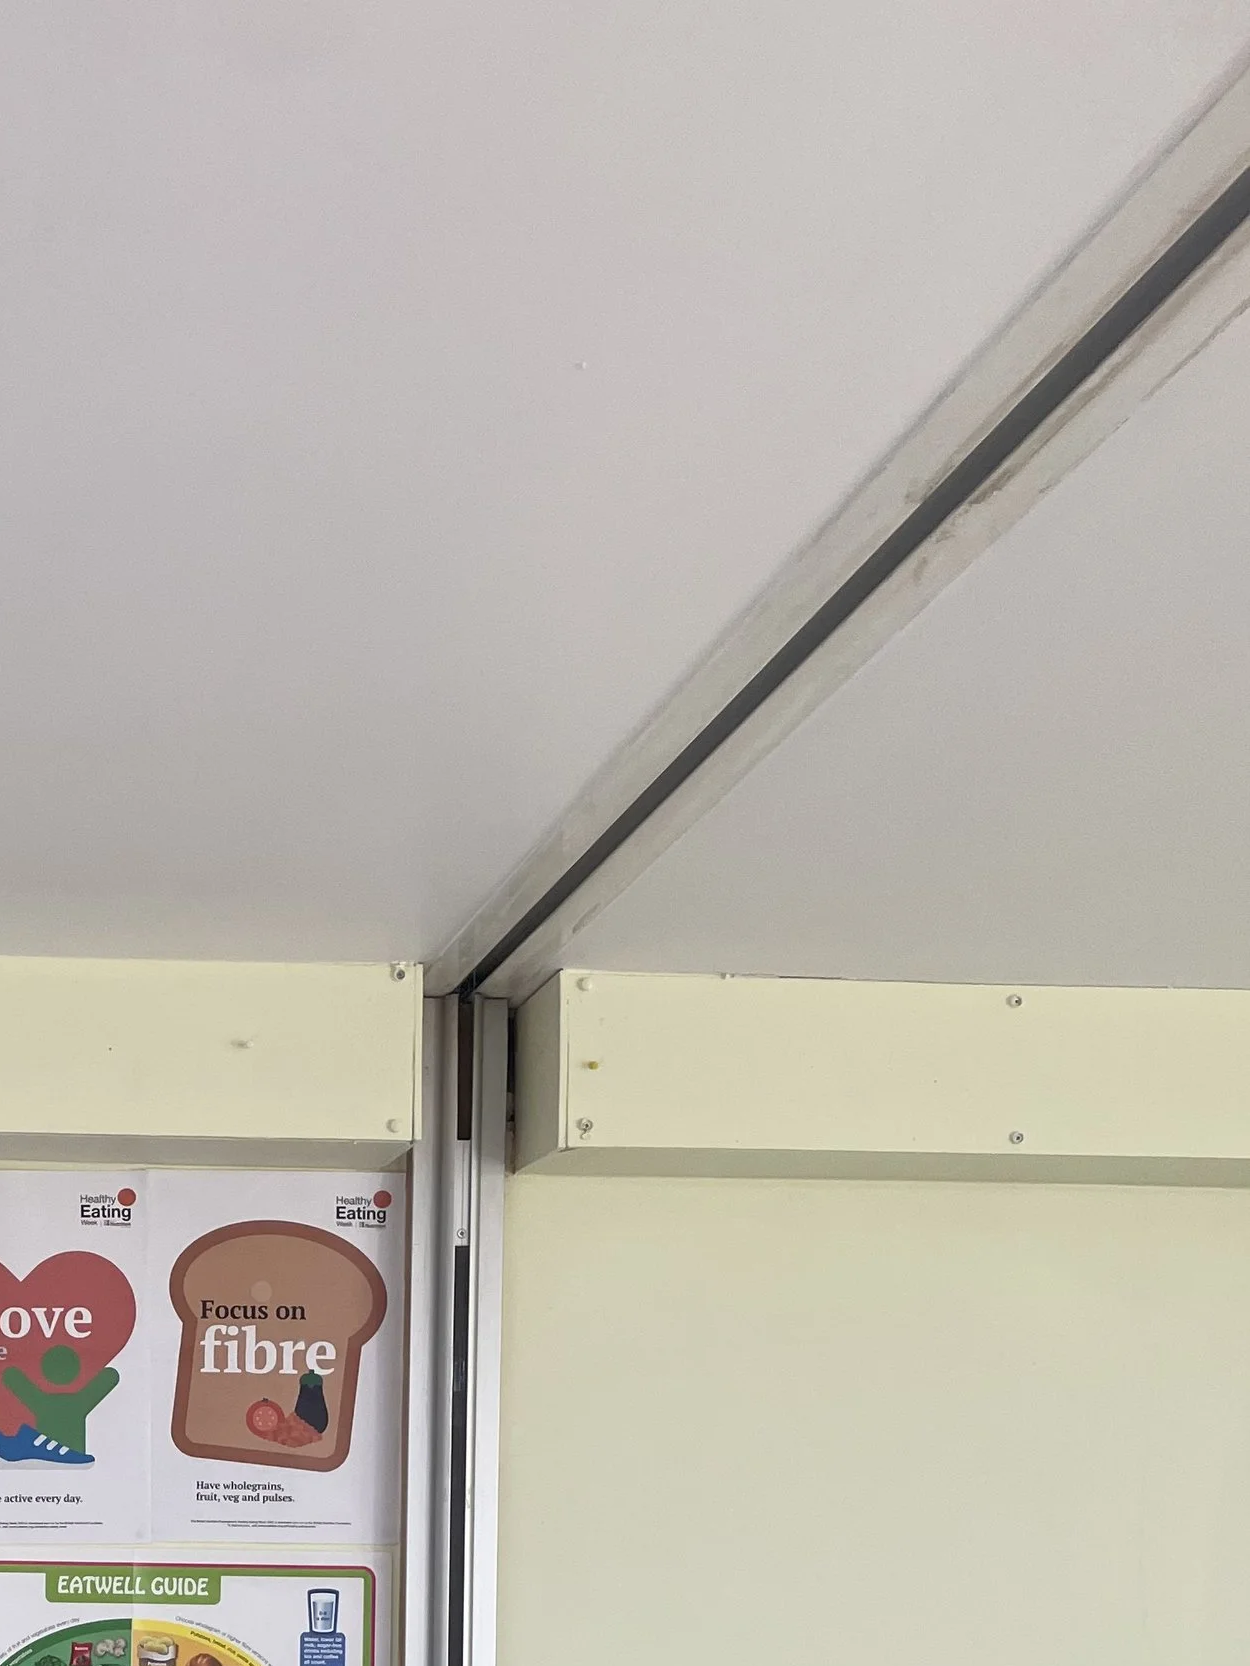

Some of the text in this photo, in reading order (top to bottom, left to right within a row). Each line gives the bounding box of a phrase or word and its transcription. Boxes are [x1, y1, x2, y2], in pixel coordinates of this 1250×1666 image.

[80, 1194, 116, 1205] Healthy
[336, 1196, 372, 1207] Healthy
[81, 1204, 131, 1221] Eating
[336, 1206, 386, 1223] Eating
[200, 1300, 306, 1321] Focus on
[200, 1325, 337, 1376] fibre
[196, 1481, 284, 1492] Have wholegrains,
[4, 1493, 33, 1503] active
[35, 1496, 61, 1504] every
[63, 1494, 83, 1504] day.
[196, 1492, 294, 1503] fruit, veg and pulses.
[58, 1575, 209, 1596] EATWELL GUIDE
